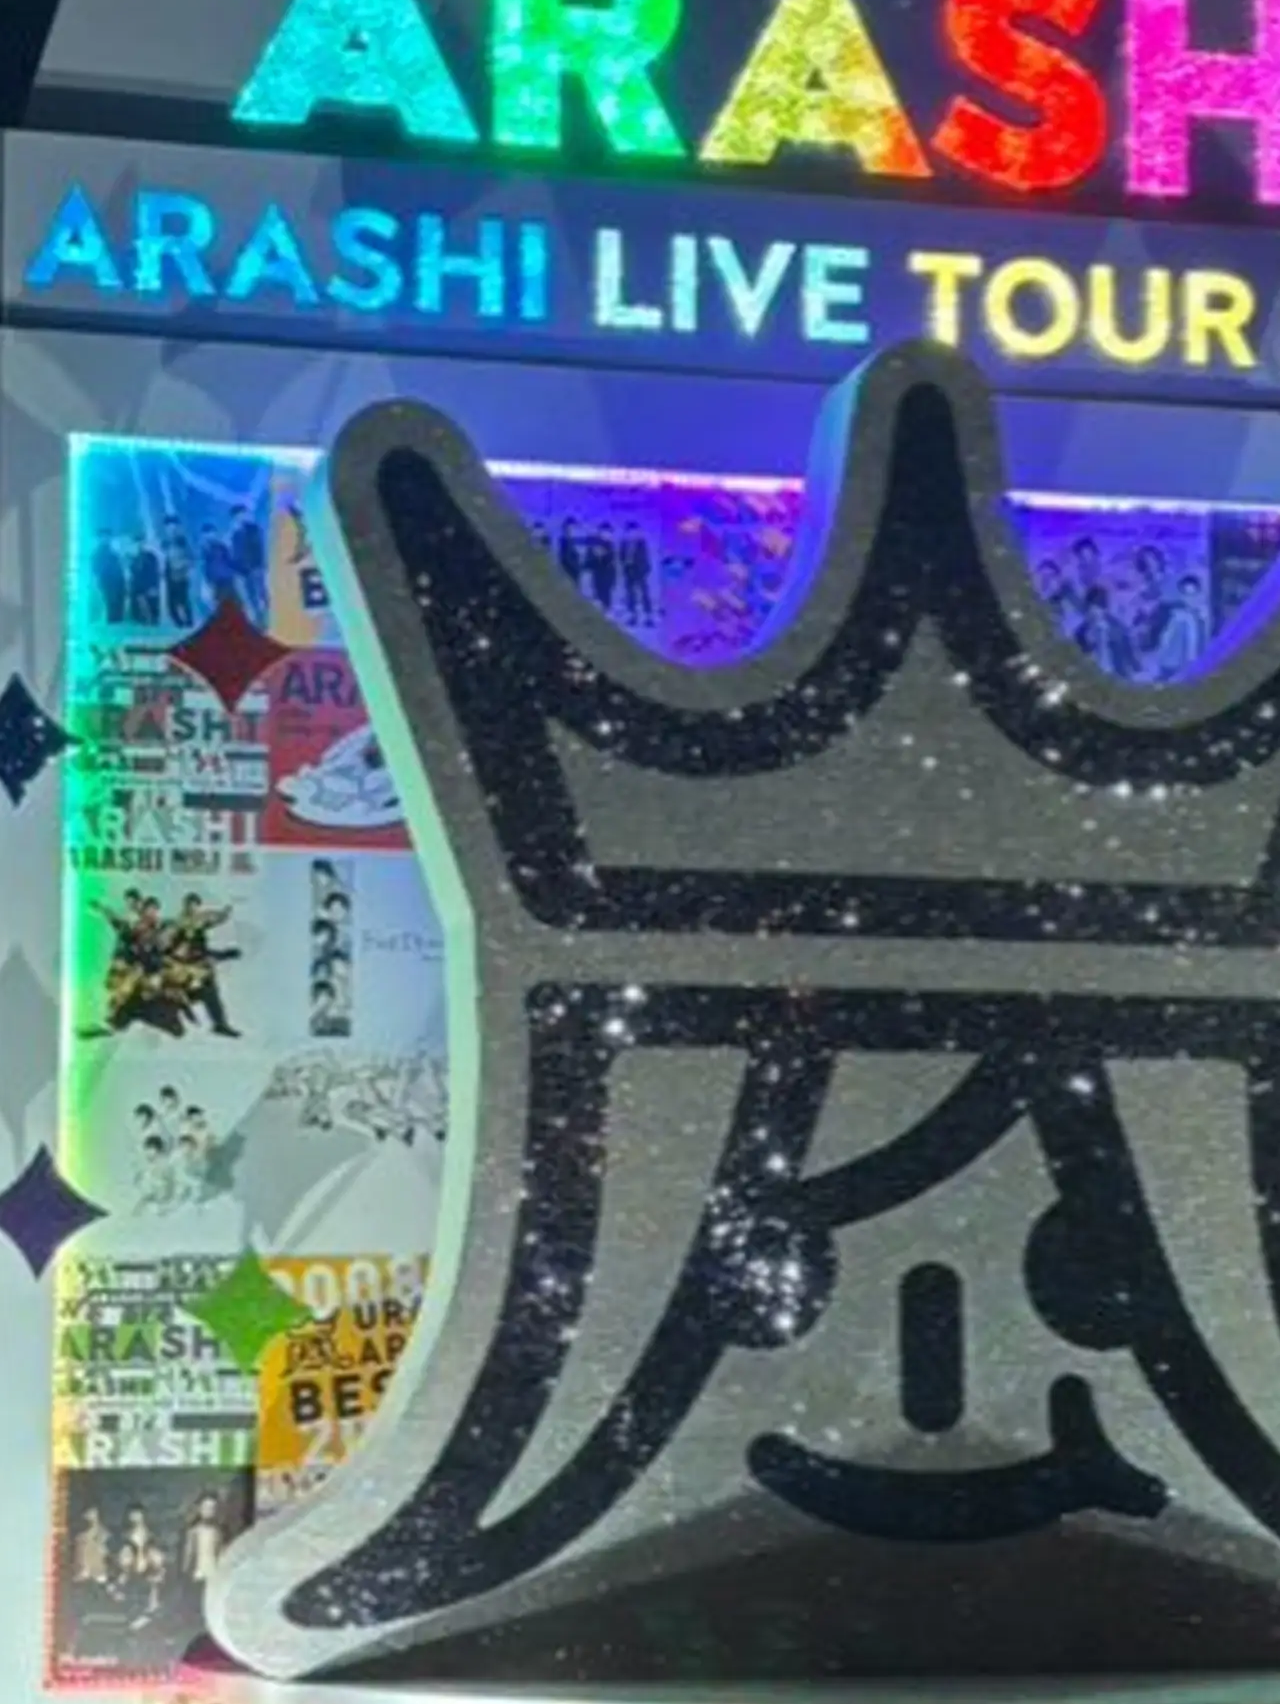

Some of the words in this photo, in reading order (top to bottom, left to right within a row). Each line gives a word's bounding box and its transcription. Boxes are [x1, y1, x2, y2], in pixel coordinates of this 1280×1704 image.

[25, 181, 548, 321] ARASHI
[593, 229, 870, 344] LIVE
[909, 251, 1257, 368] TOUR
